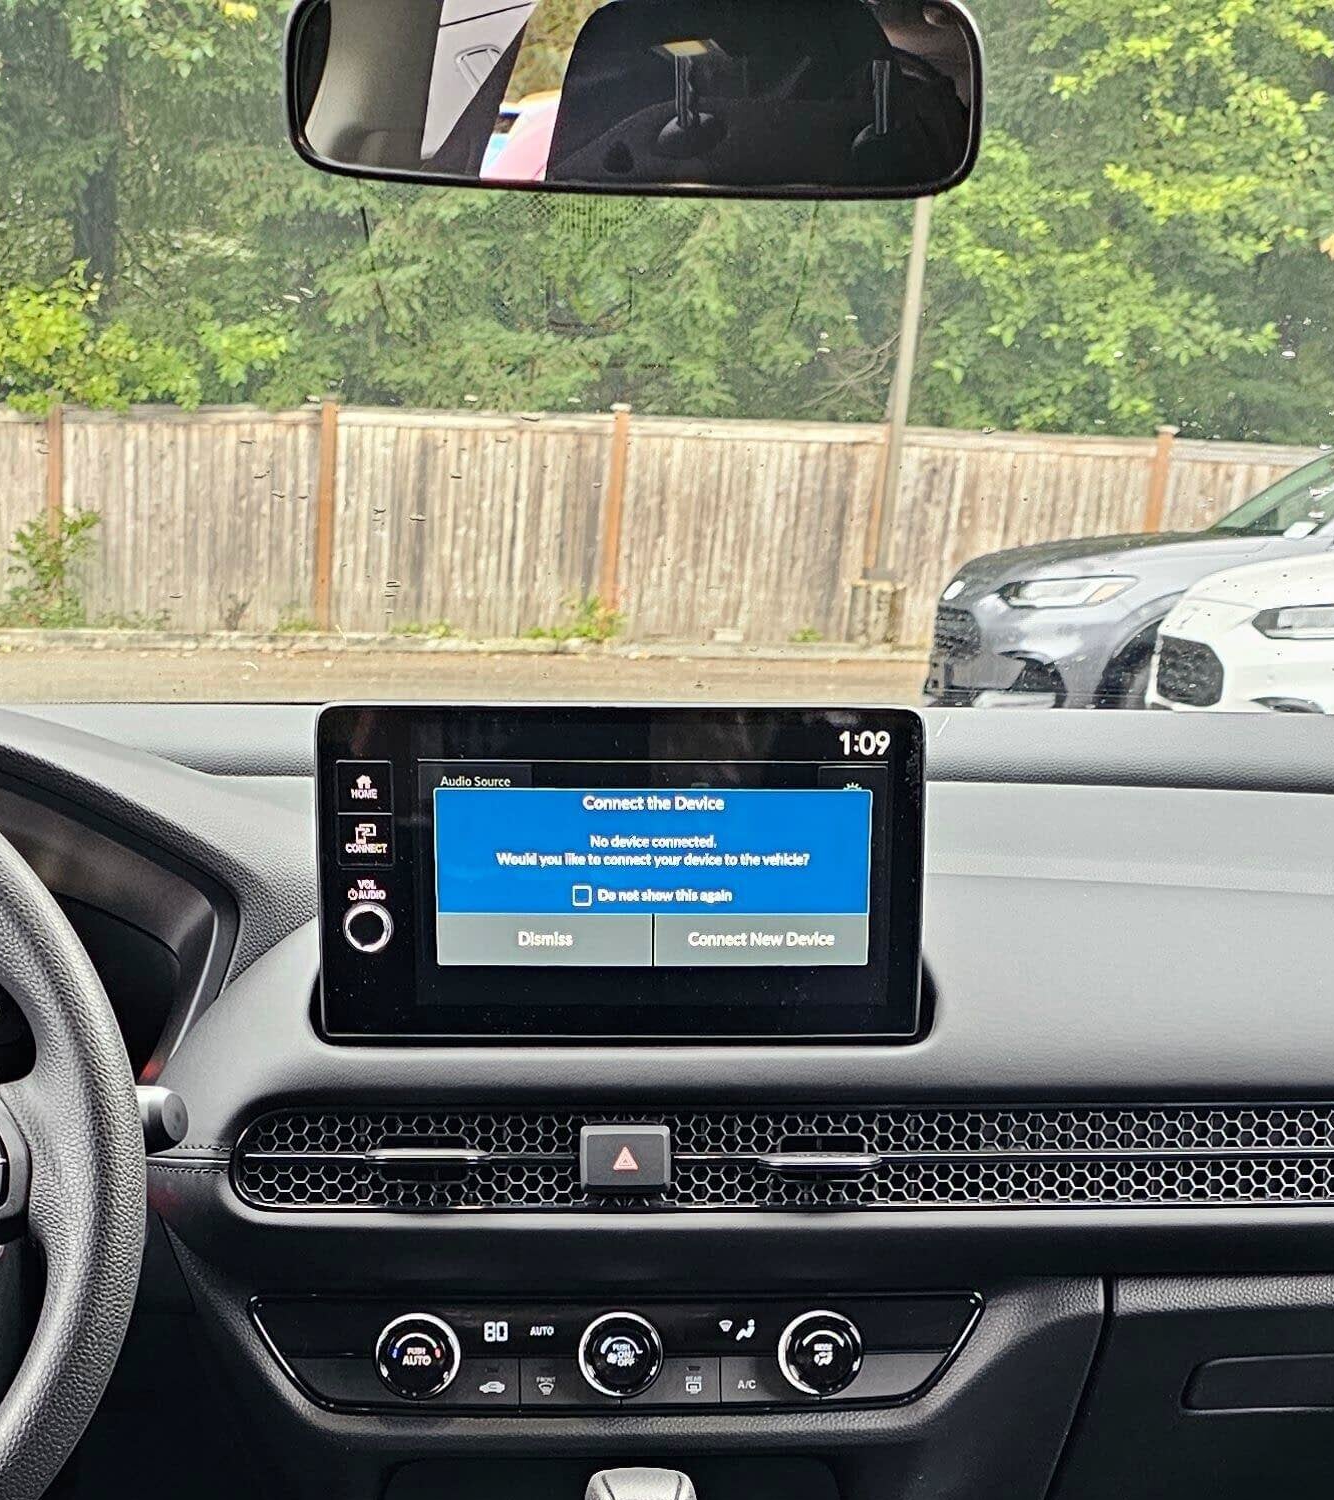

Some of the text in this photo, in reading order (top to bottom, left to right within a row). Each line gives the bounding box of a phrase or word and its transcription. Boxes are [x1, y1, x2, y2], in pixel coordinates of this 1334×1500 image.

[838, 730, 891, 756] 1:09
[439, 776, 511, 787] Audio Source
[350, 788, 378, 799] HOME
[582, 795, 725, 811] Connect the Device
[590, 834, 718, 849] No device connected.
[345, 843, 388, 854] CONNECT
[496, 852, 810, 869] Would you like to connect your device to the vehicle?
[356, 879, 377, 890] VOL
[358, 889, 387, 900] AUDIO
[597, 888, 733, 904] Do not show this again
[517, 930, 574, 947] Dismiss
[687, 930, 836, 947] Connect New Device
[483, 1321, 509, 1342] 80
[529, 1325, 555, 1337] AUTO
[402, 1355, 432, 1366] AUTO
[737, 1380, 757, 1390] A/C
